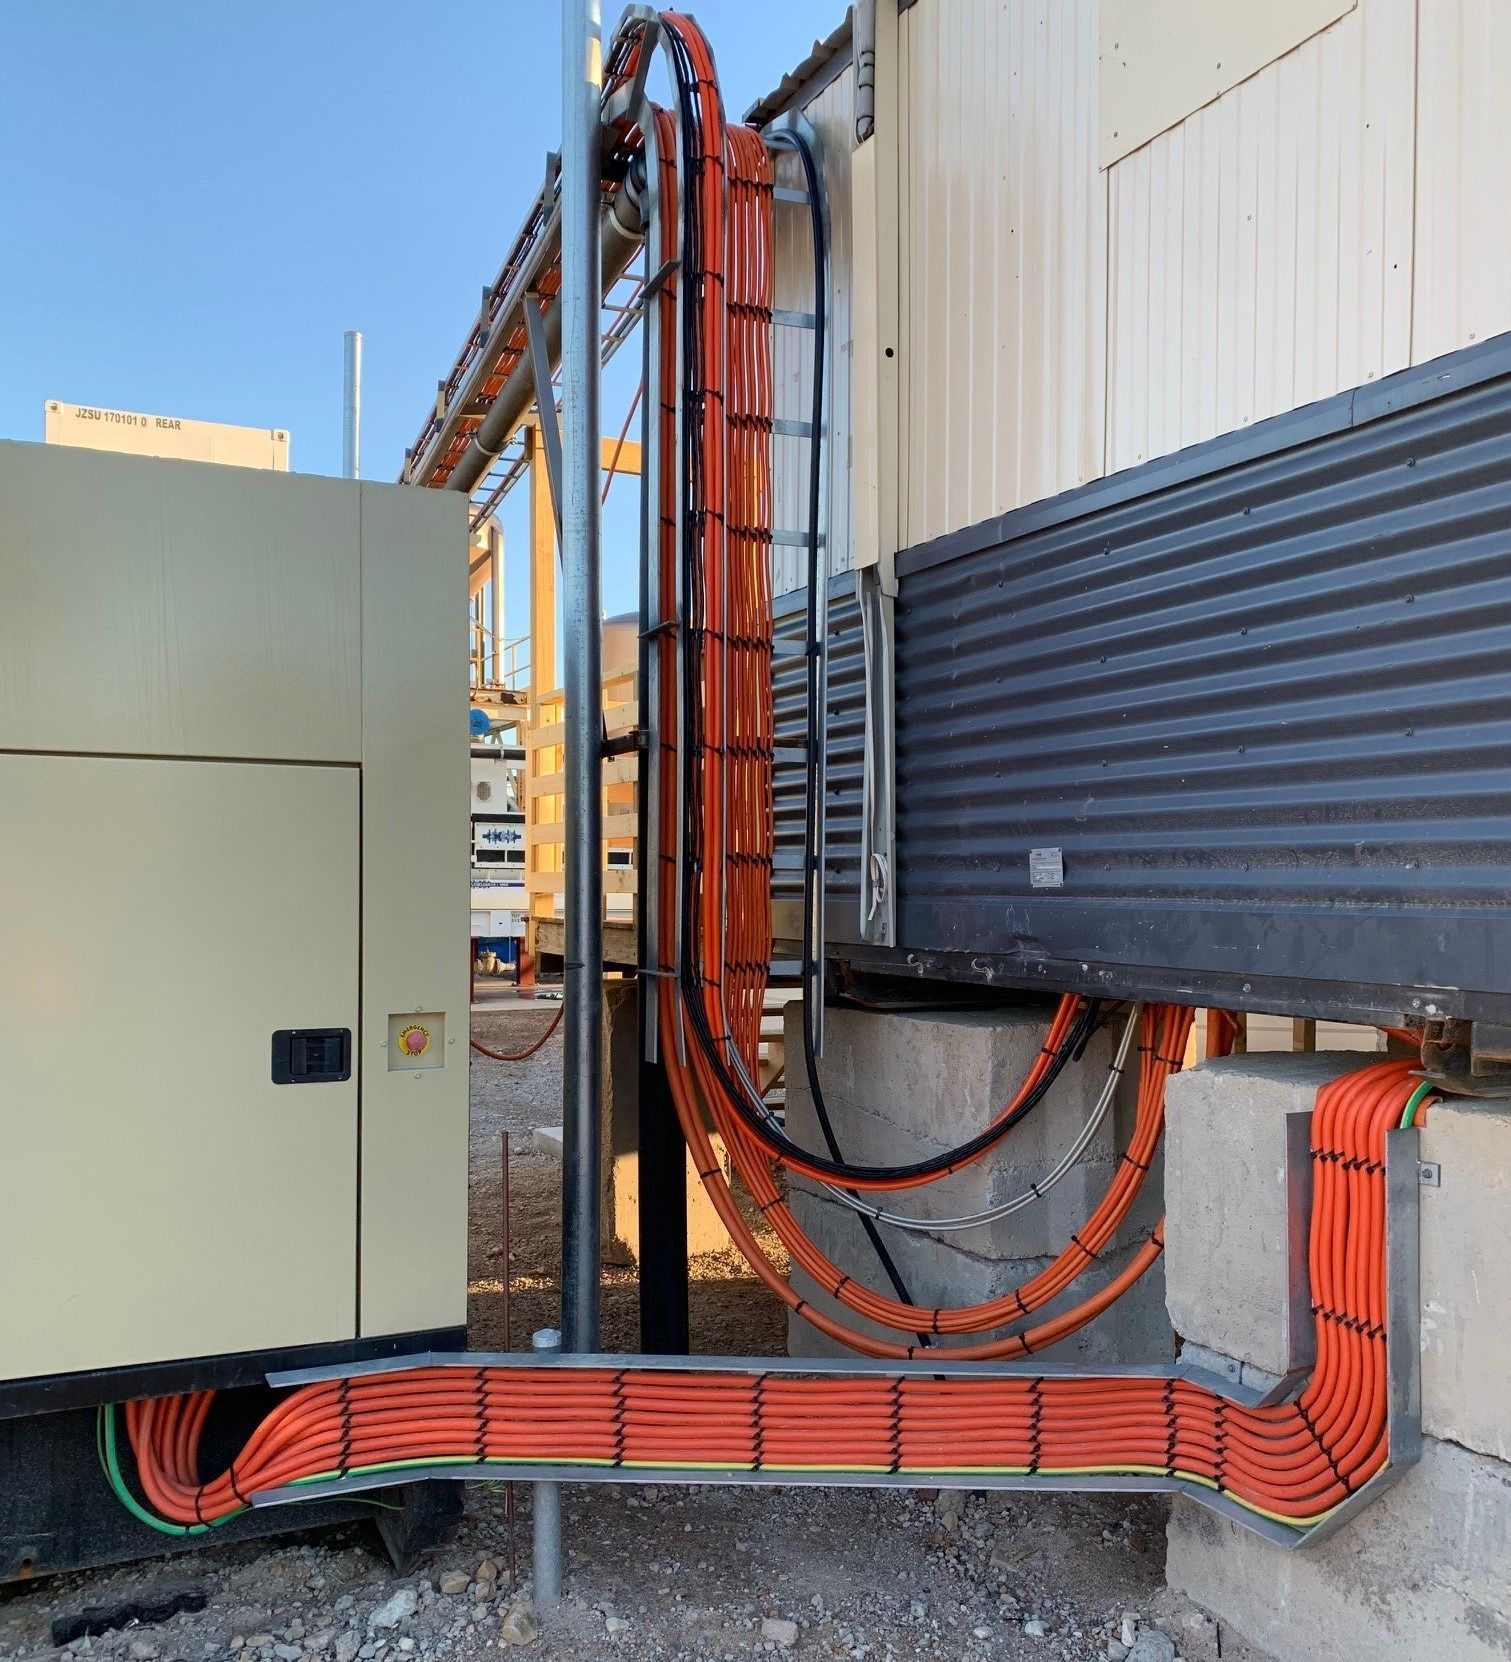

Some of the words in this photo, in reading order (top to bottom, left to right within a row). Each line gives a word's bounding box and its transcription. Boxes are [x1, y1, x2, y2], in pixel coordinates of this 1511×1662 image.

[75, 407, 101, 420] JZSU
[104, 412, 137, 426] 170101
[155, 418, 181, 430] REAR
[400, 1025, 429, 1038] EMERGENCY
